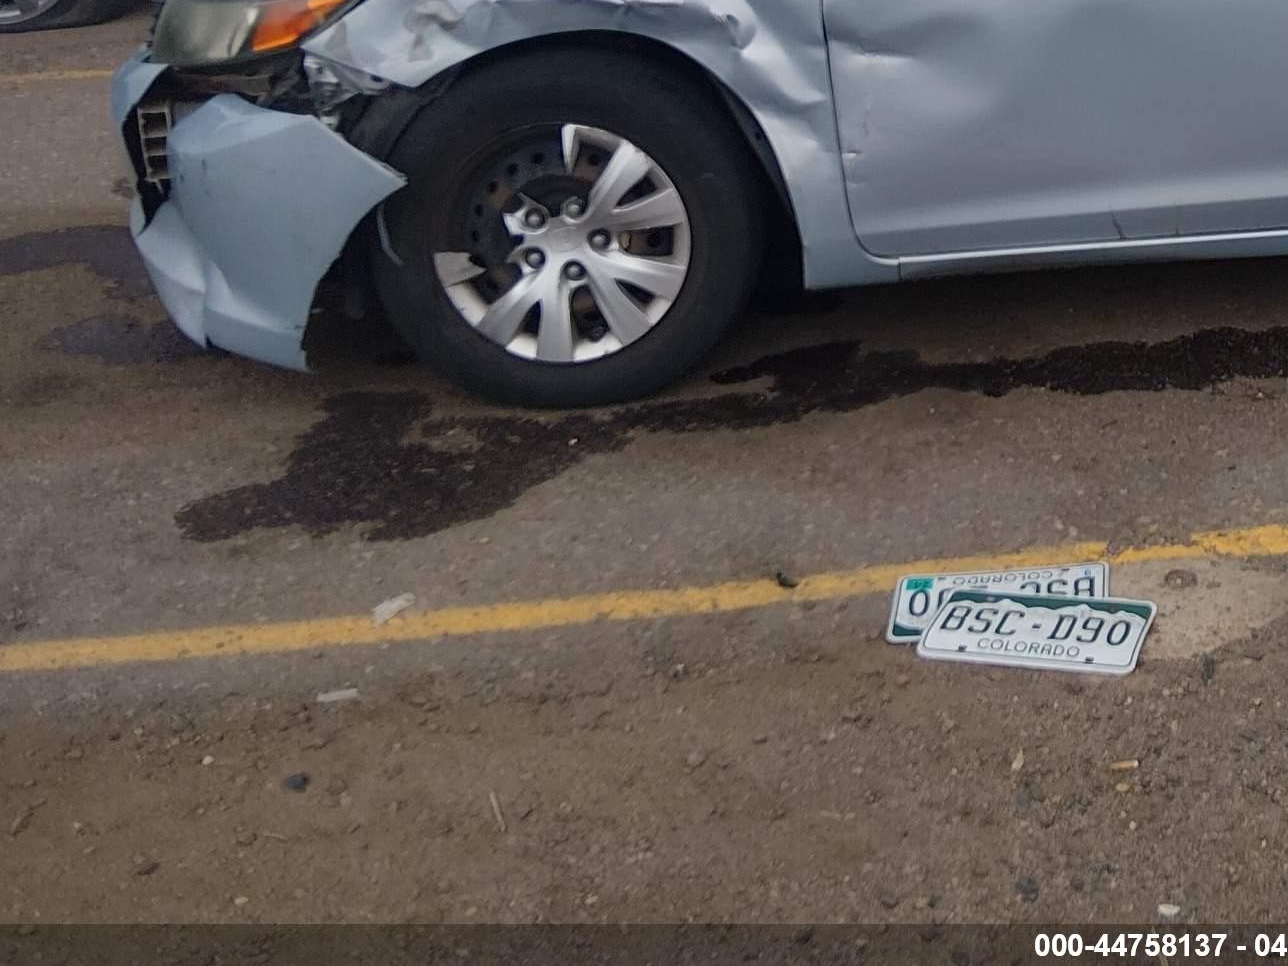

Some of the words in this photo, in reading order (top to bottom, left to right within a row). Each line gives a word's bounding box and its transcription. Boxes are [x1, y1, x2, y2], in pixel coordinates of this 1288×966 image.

[953, 570, 1054, 585] COLORADO
[940, 605, 1132, 646] BSC-D90
[976, 638, 1081, 658] COLORADO
